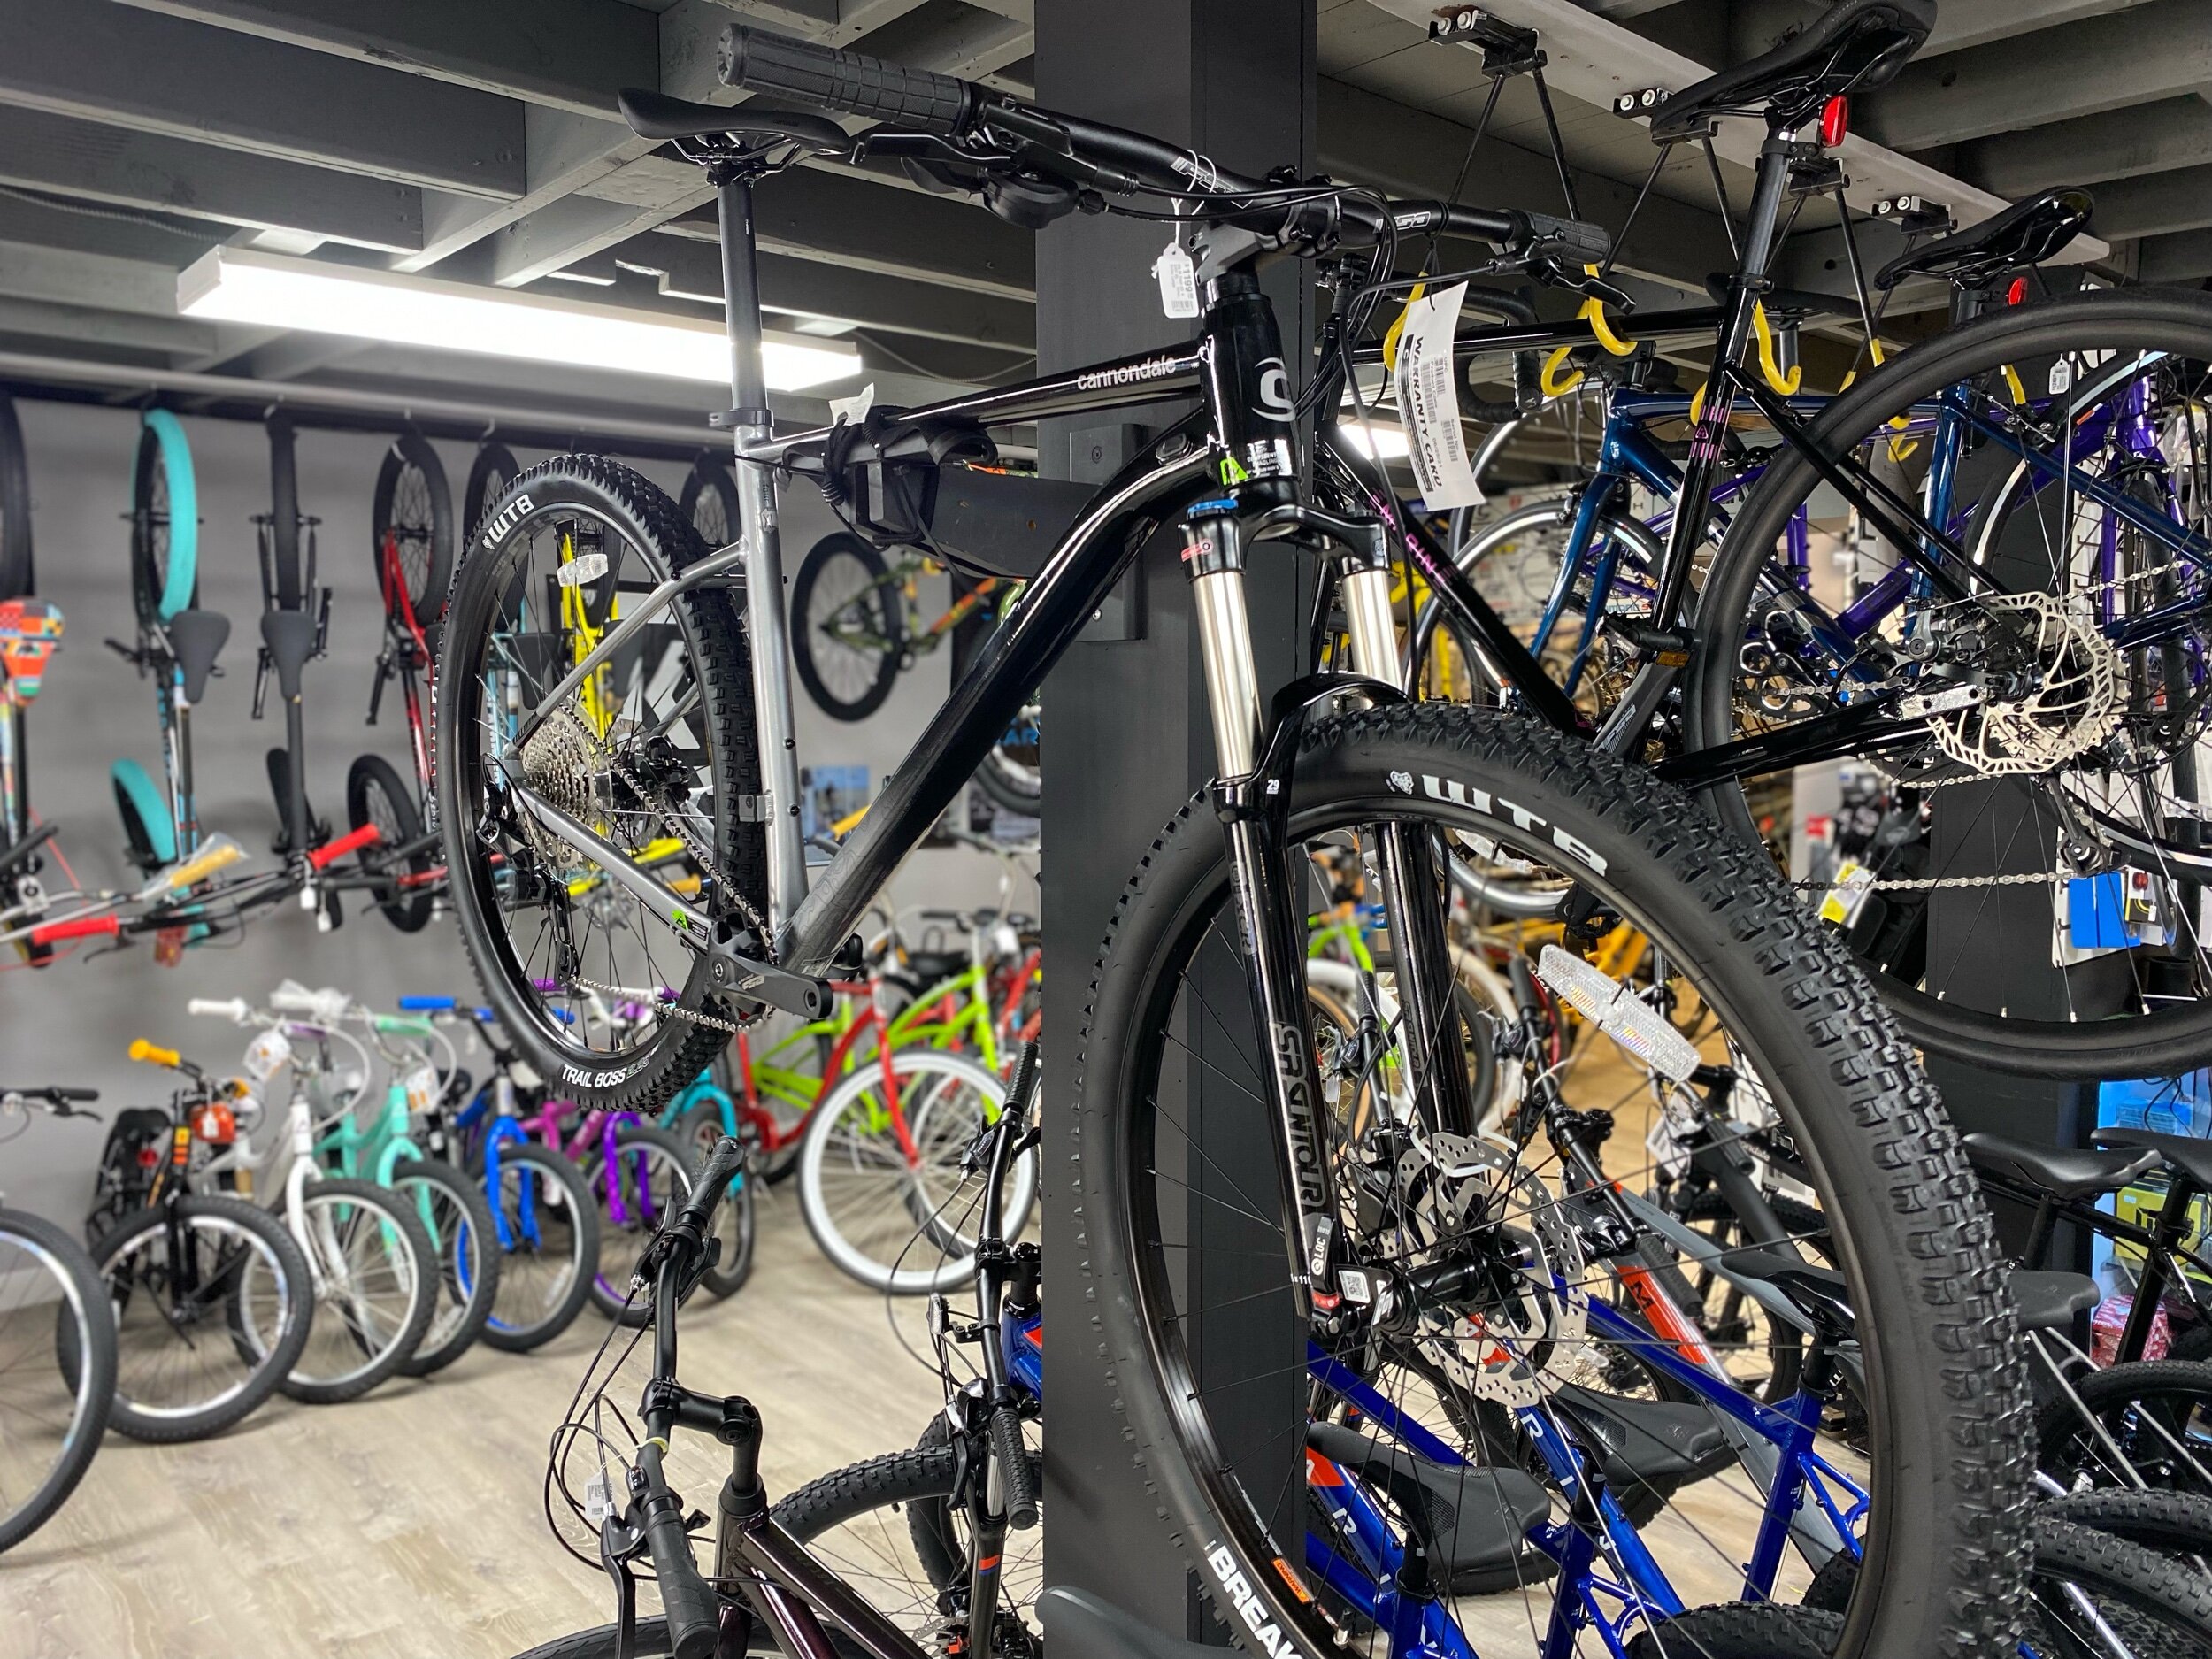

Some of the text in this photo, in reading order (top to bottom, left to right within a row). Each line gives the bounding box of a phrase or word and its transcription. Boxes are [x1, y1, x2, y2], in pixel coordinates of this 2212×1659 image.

[1077, 355, 1177, 390] cannondale
[1412, 336, 1428, 437] WARRANTY
[1425, 443, 1442, 488] CARD
[488, 494, 534, 543] WTB
[1266, 778, 1280, 790] 29
[1422, 775, 1609, 877] WTB
[562, 1064, 592, 1087] TRAIL
[594, 1067, 627, 1087] BOSS
[1284, 1079, 1324, 1208] SUNTOUR
[1276, 1561, 1302, 1594] WARNING
